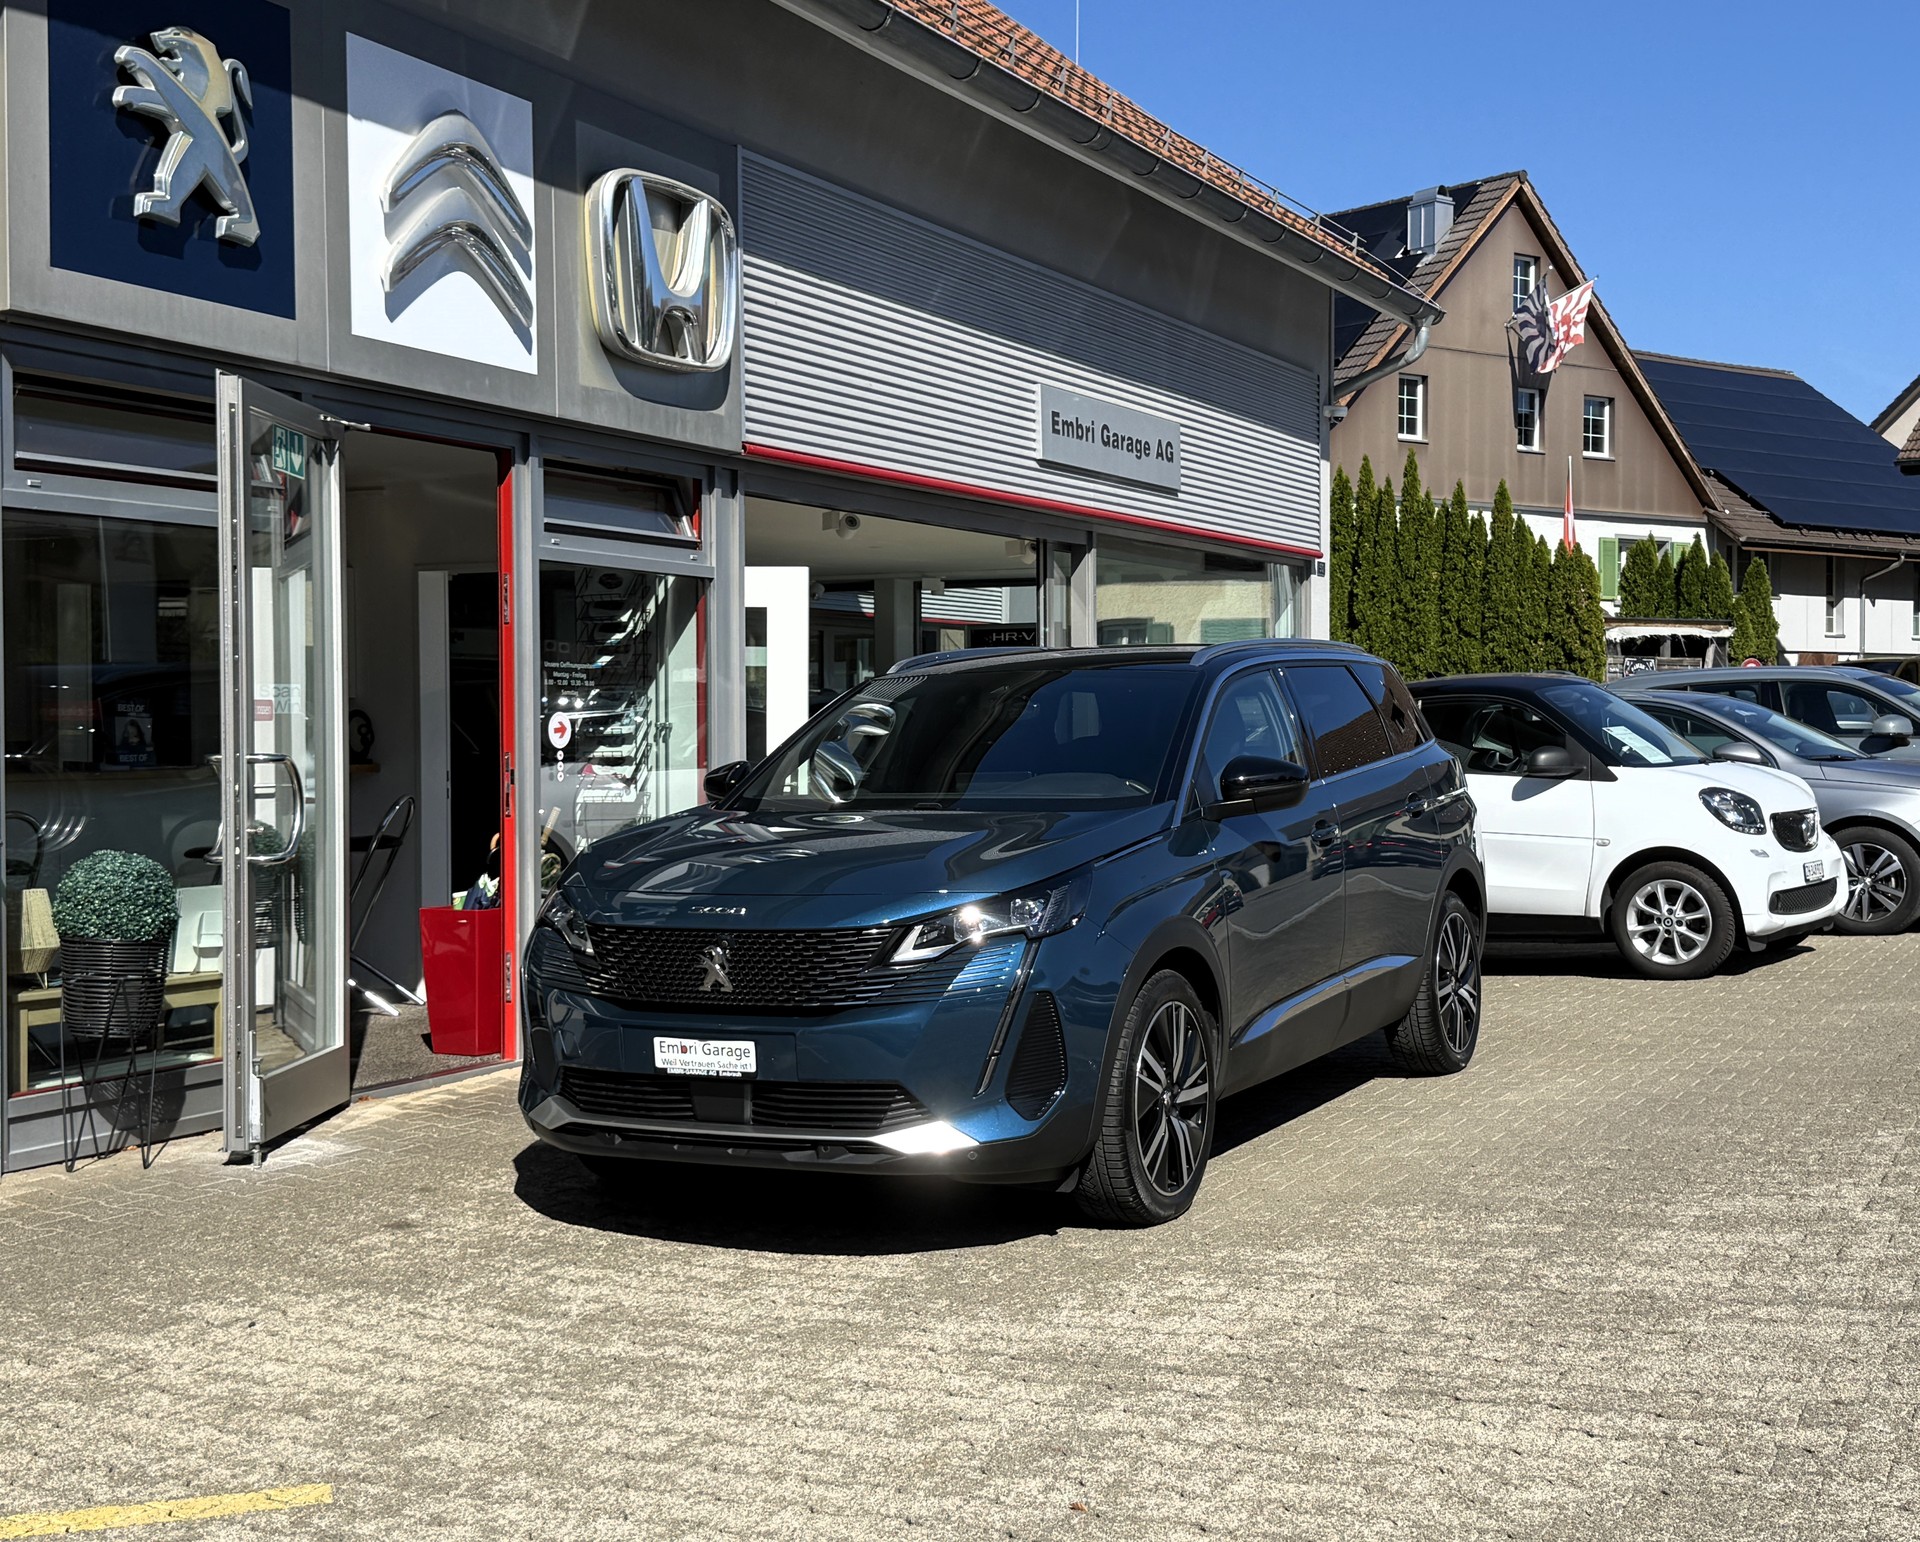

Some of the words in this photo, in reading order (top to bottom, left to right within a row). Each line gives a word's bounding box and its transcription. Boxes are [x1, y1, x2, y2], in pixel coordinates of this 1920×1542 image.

[1051, 410, 1095, 443] Embri
[1100, 423, 1151, 460] Garage
[1155, 438, 1174, 464] AG
[992, 631, 1035, 642] HR-V
[553, 671, 570, 679] Montag
[561, 689, 579, 697] Samstag
[117, 703, 135, 712] BEST
[135, 704, 145, 712] OF
[659, 1040, 698, 1055] Embri
[701, 1042, 751, 1061] Garage
[661, 1058, 677, 1066] Weil
[679, 1059, 716, 1068] Vertrauen
[717, 1060, 739, 1069] Sache
